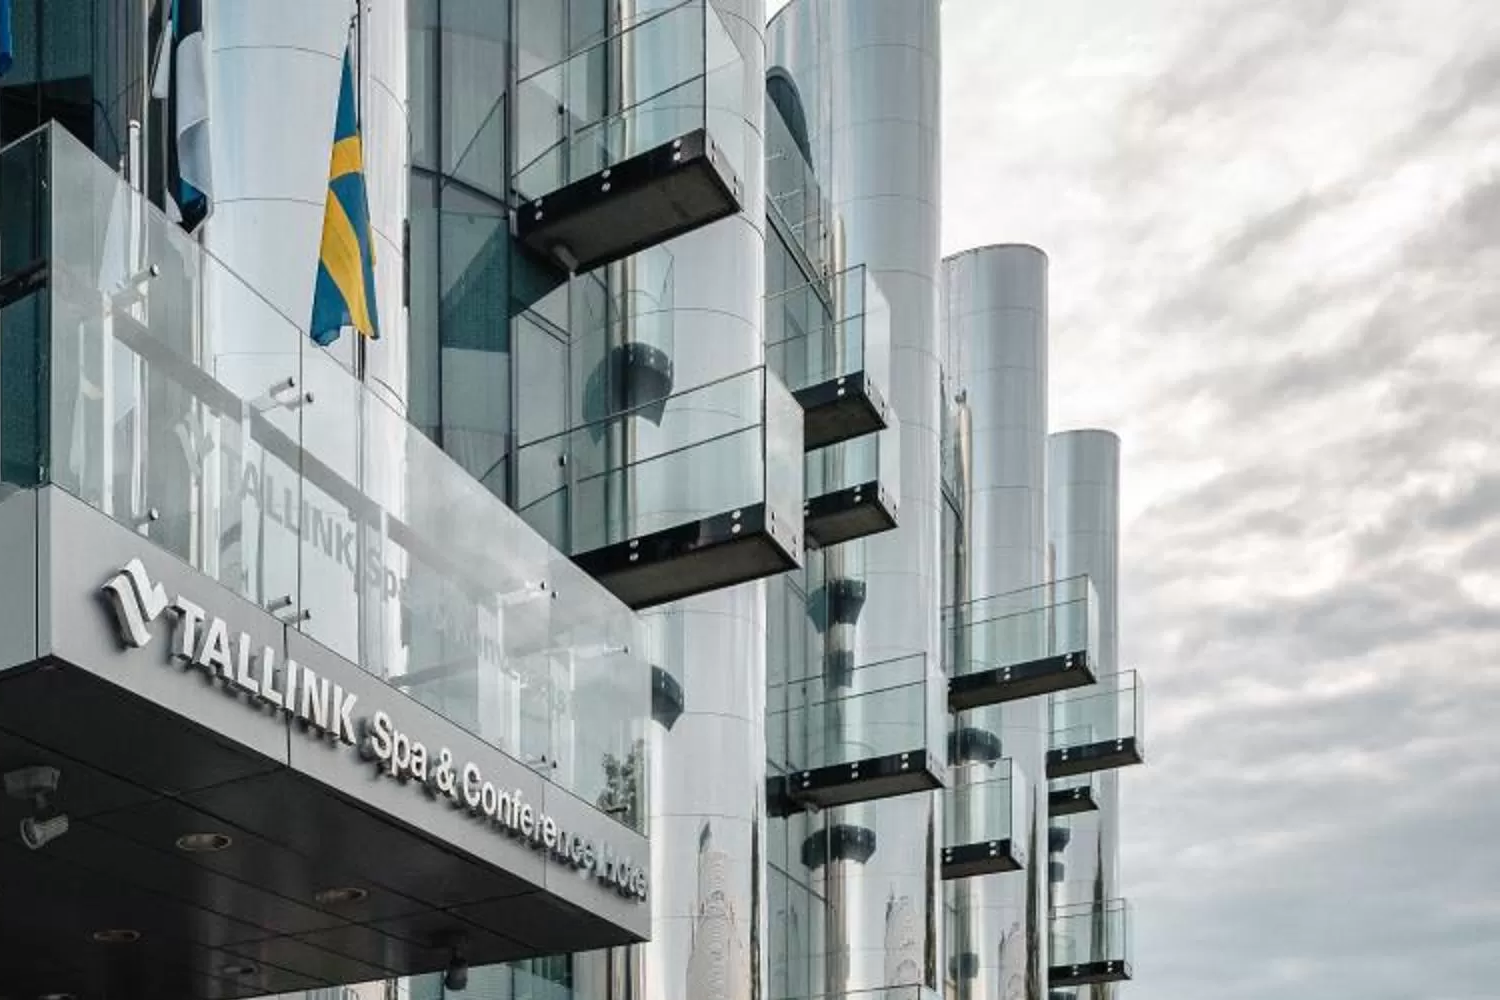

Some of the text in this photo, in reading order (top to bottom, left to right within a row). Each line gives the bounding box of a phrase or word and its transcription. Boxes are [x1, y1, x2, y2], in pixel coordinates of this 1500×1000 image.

[174, 594, 358, 746] TALLINK
[371, 711, 427, 781] Spa
[437, 747, 458, 800] &
[463, 762, 596, 870] Conference
